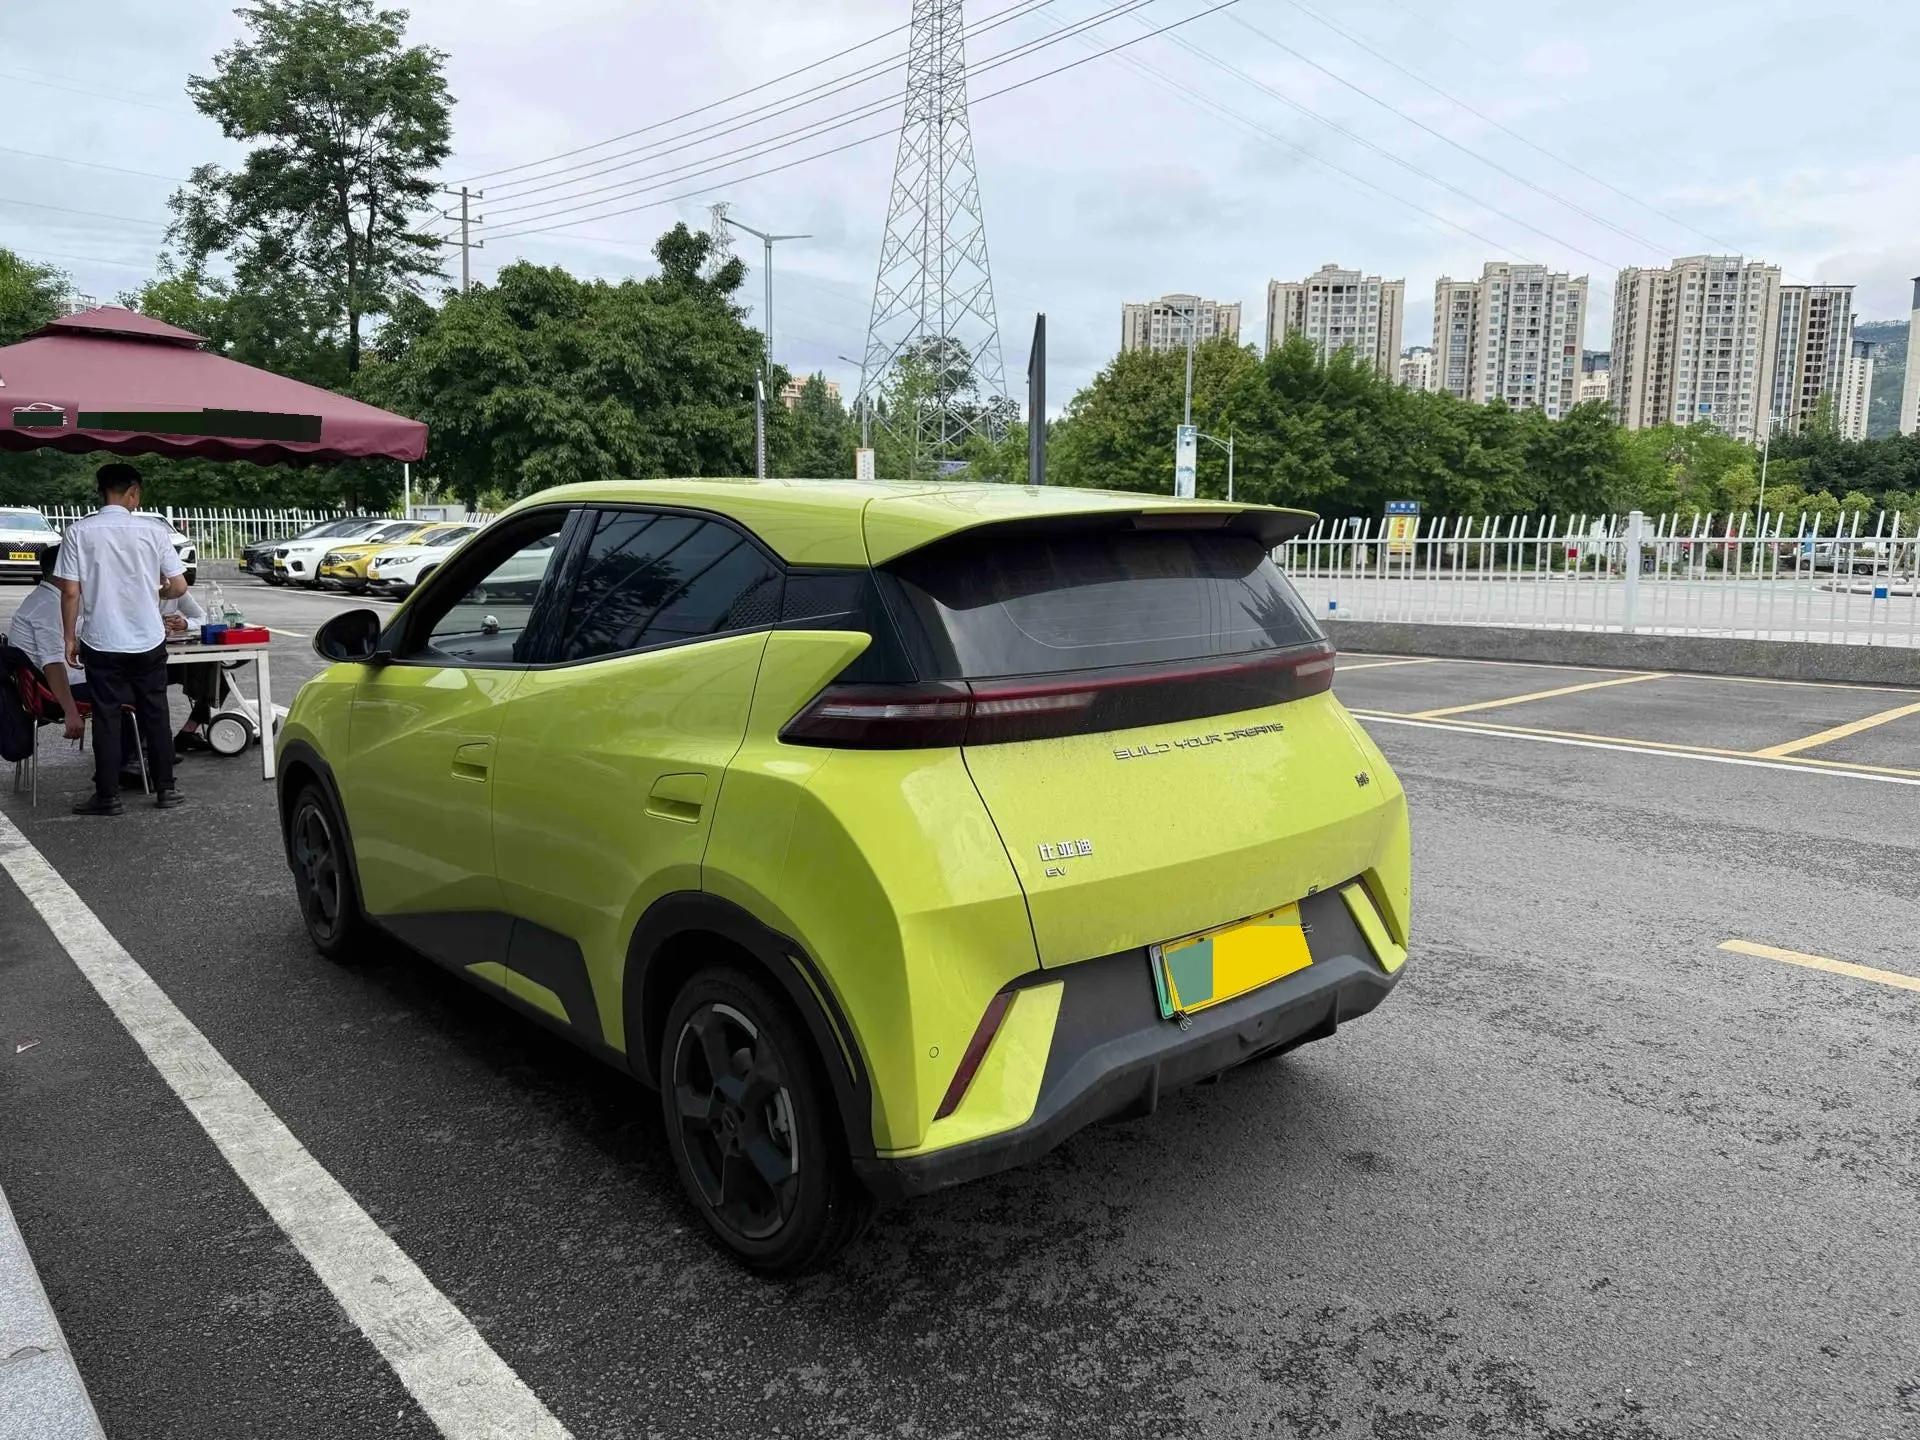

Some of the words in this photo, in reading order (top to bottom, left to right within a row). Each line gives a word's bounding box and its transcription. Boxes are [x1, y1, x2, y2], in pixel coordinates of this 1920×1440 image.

[1113, 743, 1170, 760] BUILD
[1174, 734, 1222, 749] YOUR
[1224, 723, 1283, 740] DREAMS
[1038, 840, 1092, 861] 比亚迪
[1045, 867, 1066, 877] EV
